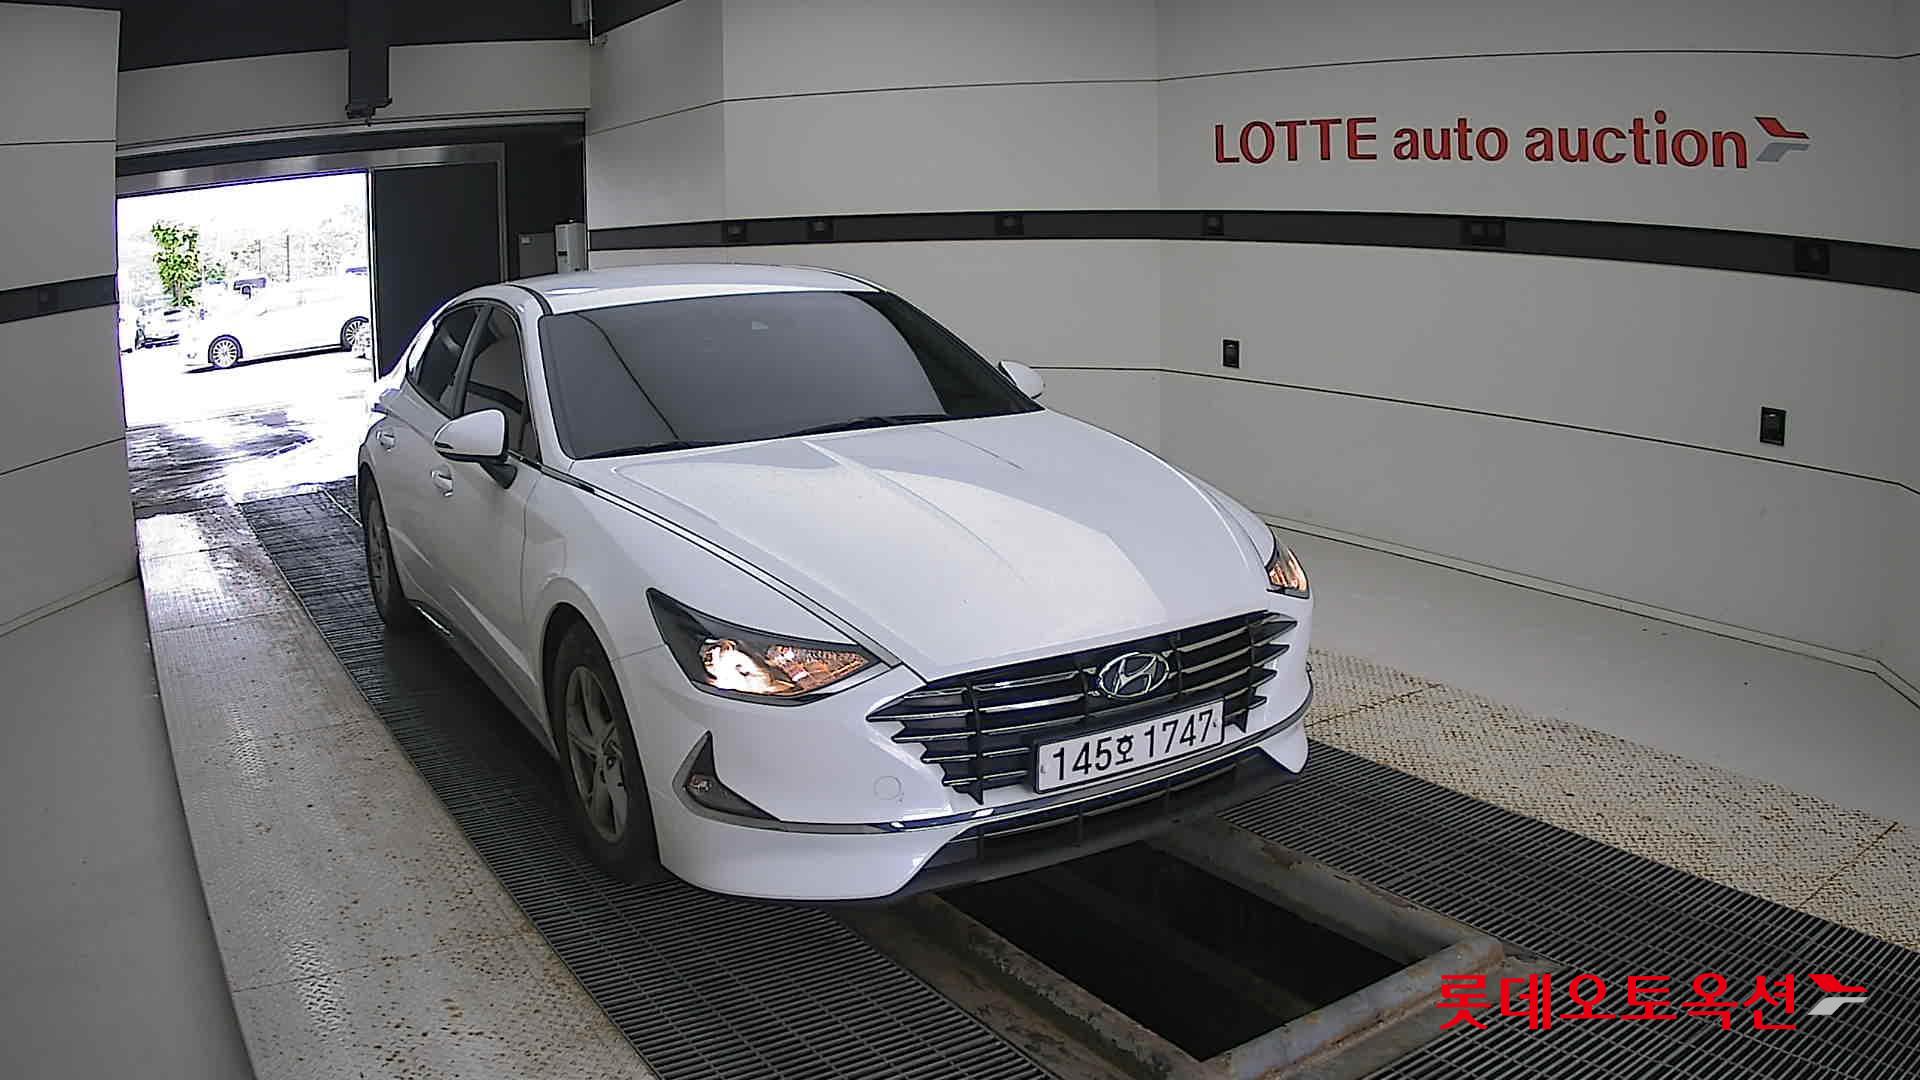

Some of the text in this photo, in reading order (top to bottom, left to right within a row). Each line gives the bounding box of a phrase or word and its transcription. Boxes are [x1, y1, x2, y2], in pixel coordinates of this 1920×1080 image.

[1216, 110, 1748, 168] LOTTE auto auction
[1052, 709, 1213, 780] 145호 1747
